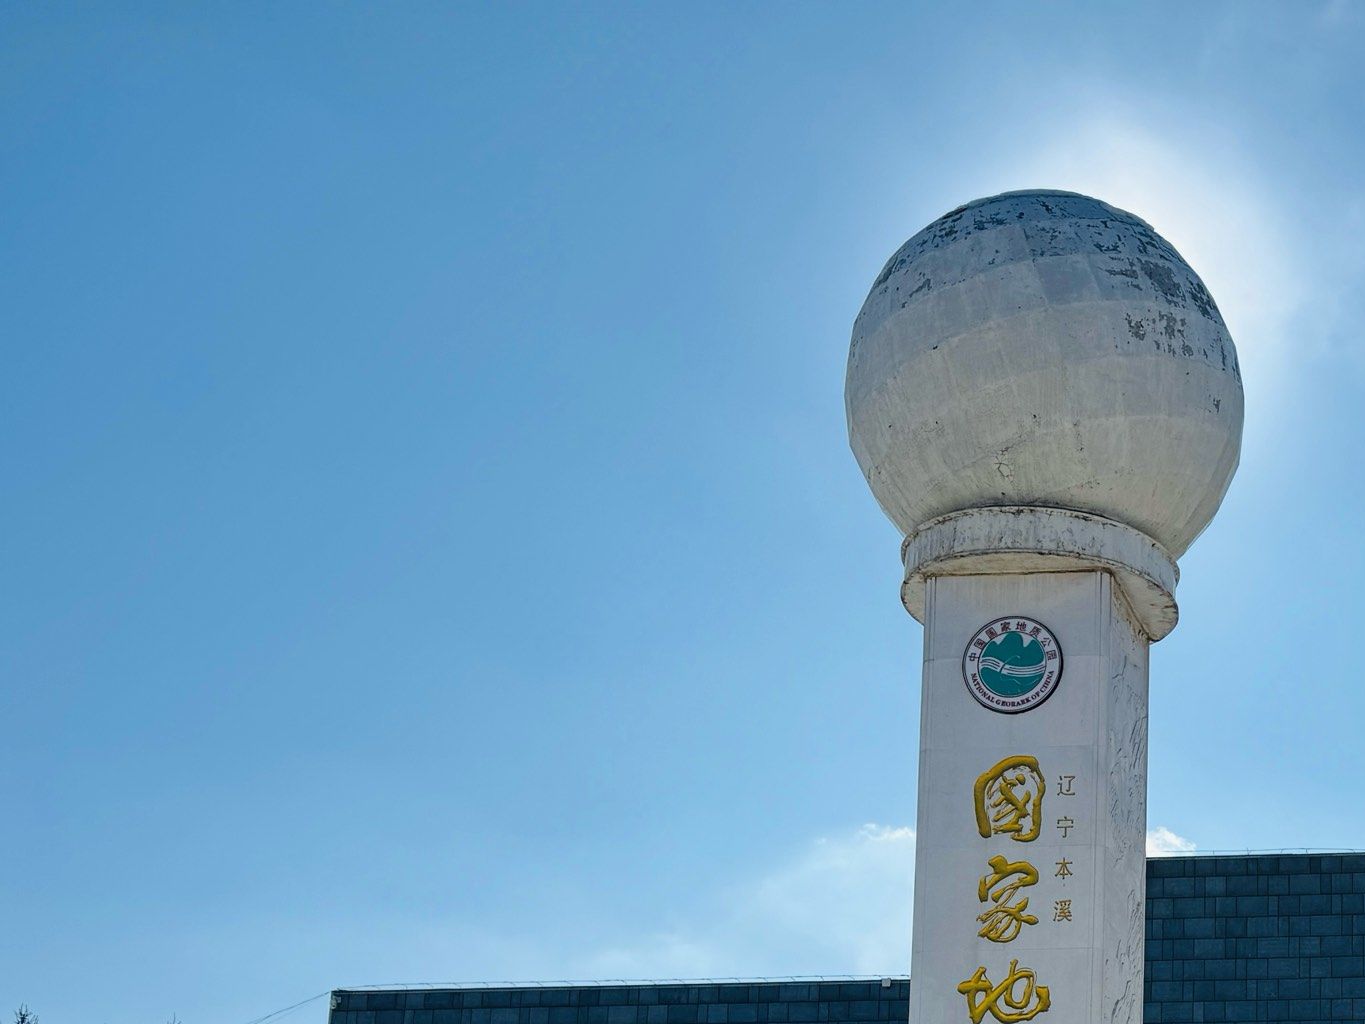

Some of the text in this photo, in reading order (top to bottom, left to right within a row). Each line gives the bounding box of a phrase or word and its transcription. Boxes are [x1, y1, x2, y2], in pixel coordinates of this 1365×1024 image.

[971, 672, 995, 703] NATIONAL
[1031, 691, 1042, 701] OF
[1040, 670, 1056, 693] CHINA
[1052, 775, 1077, 922] 辽宁本溪
